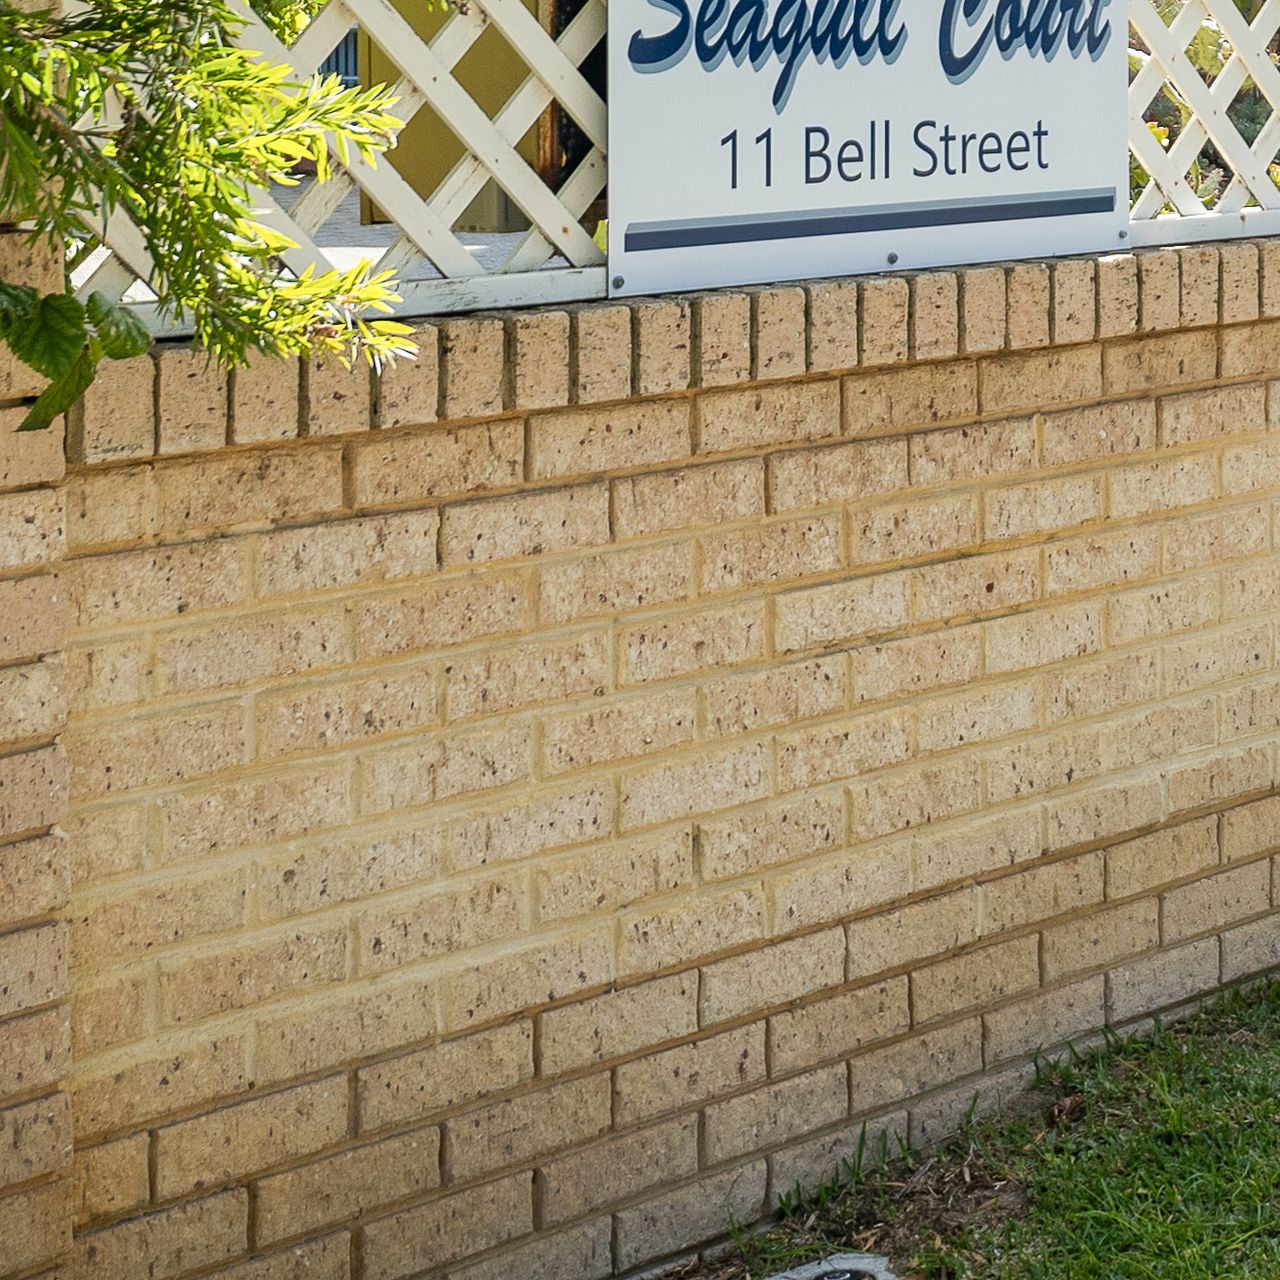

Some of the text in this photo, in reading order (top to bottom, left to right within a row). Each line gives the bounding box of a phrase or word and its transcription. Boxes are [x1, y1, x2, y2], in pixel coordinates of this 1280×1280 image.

[720, 119, 1050, 190] 11 Bell Street
